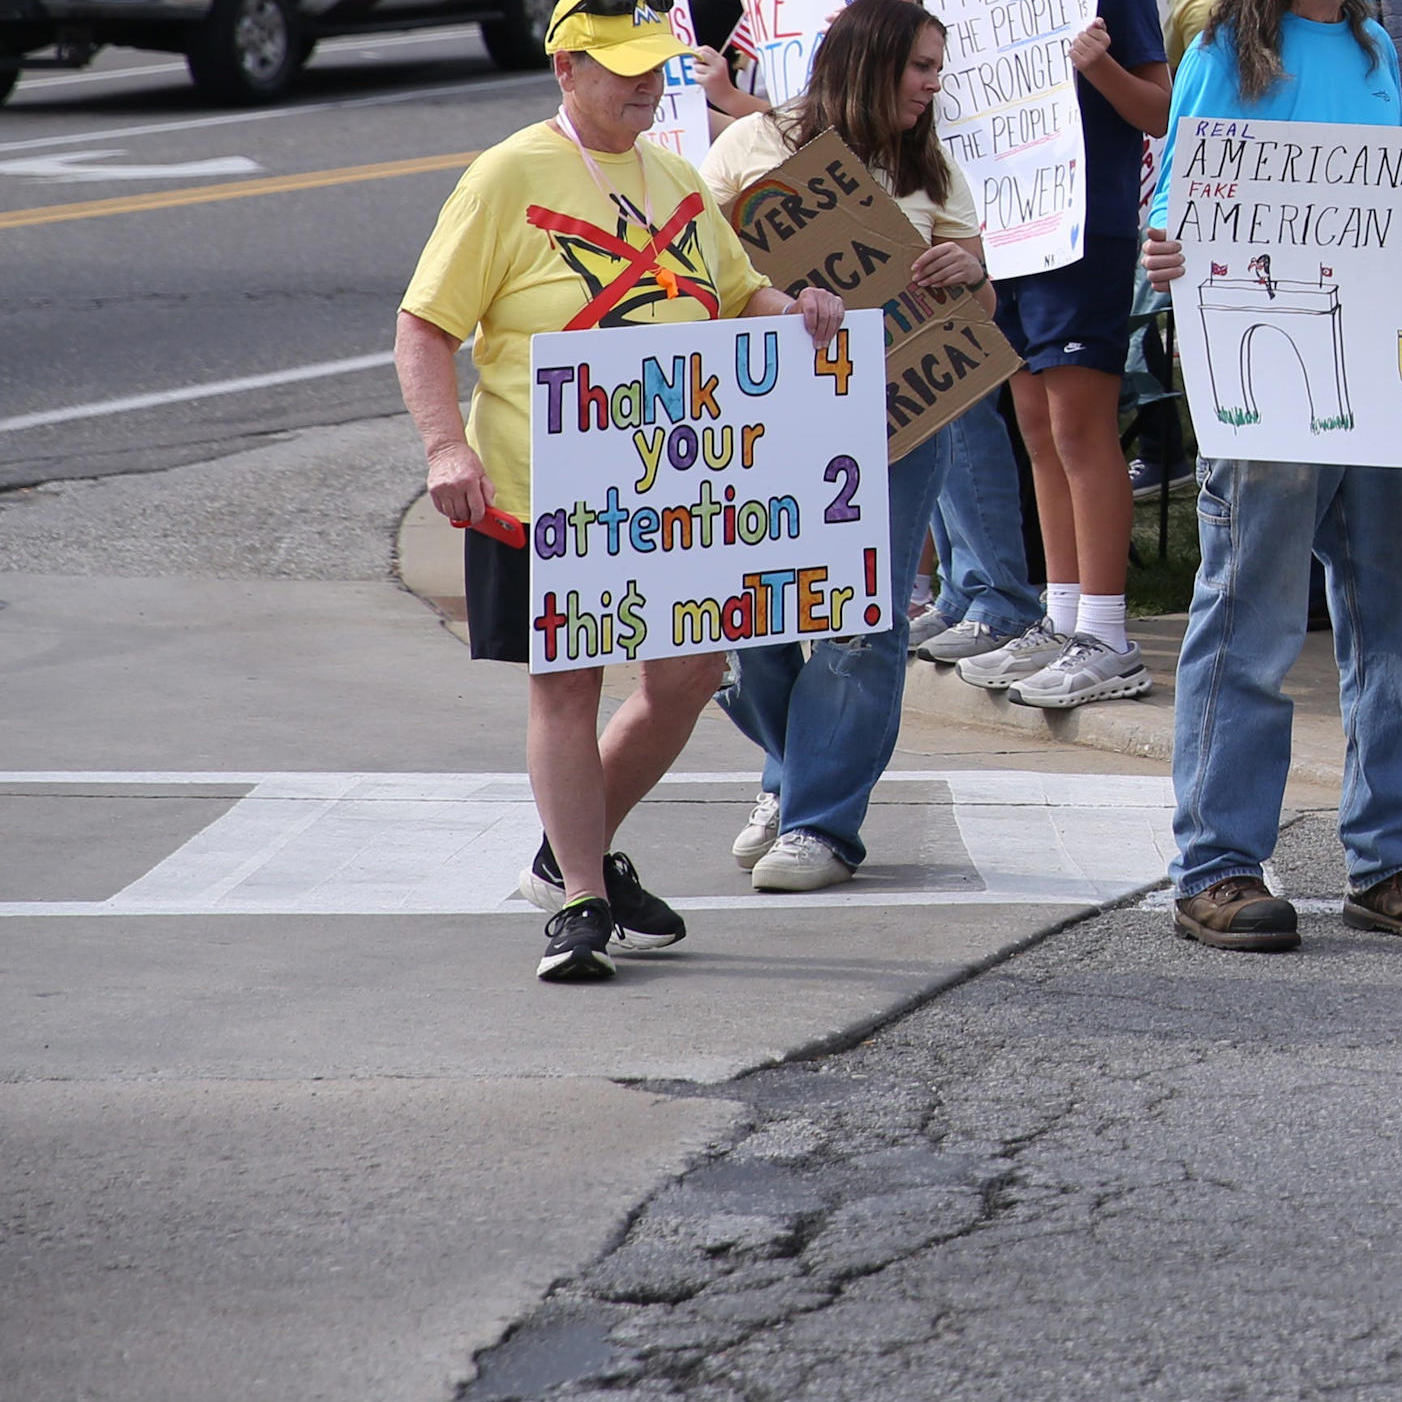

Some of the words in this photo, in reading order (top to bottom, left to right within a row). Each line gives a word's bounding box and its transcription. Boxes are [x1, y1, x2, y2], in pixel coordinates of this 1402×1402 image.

[945, 17, 987, 63] THE
[941, 37, 1074, 123] STRONGER
[941, 128, 988, 164] THE
[992, 102, 1061, 154] PEOPLE
[1195, 120, 1257, 139] REAL
[739, 159, 860, 253] VERSE
[983, 158, 1078, 231] POWER!
[1175, 200, 1393, 249] AMERICAN
[1187, 180, 1240, 199] FAKE
[784, 239, 892, 300] RICA
[735, 330, 779, 397] U
[813, 327, 853, 397] 4
[887, 326, 991, 434] RICA!
[632, 423, 765, 494] your
[534, 480, 800, 562] attention
[823, 454, 862, 524] 2
